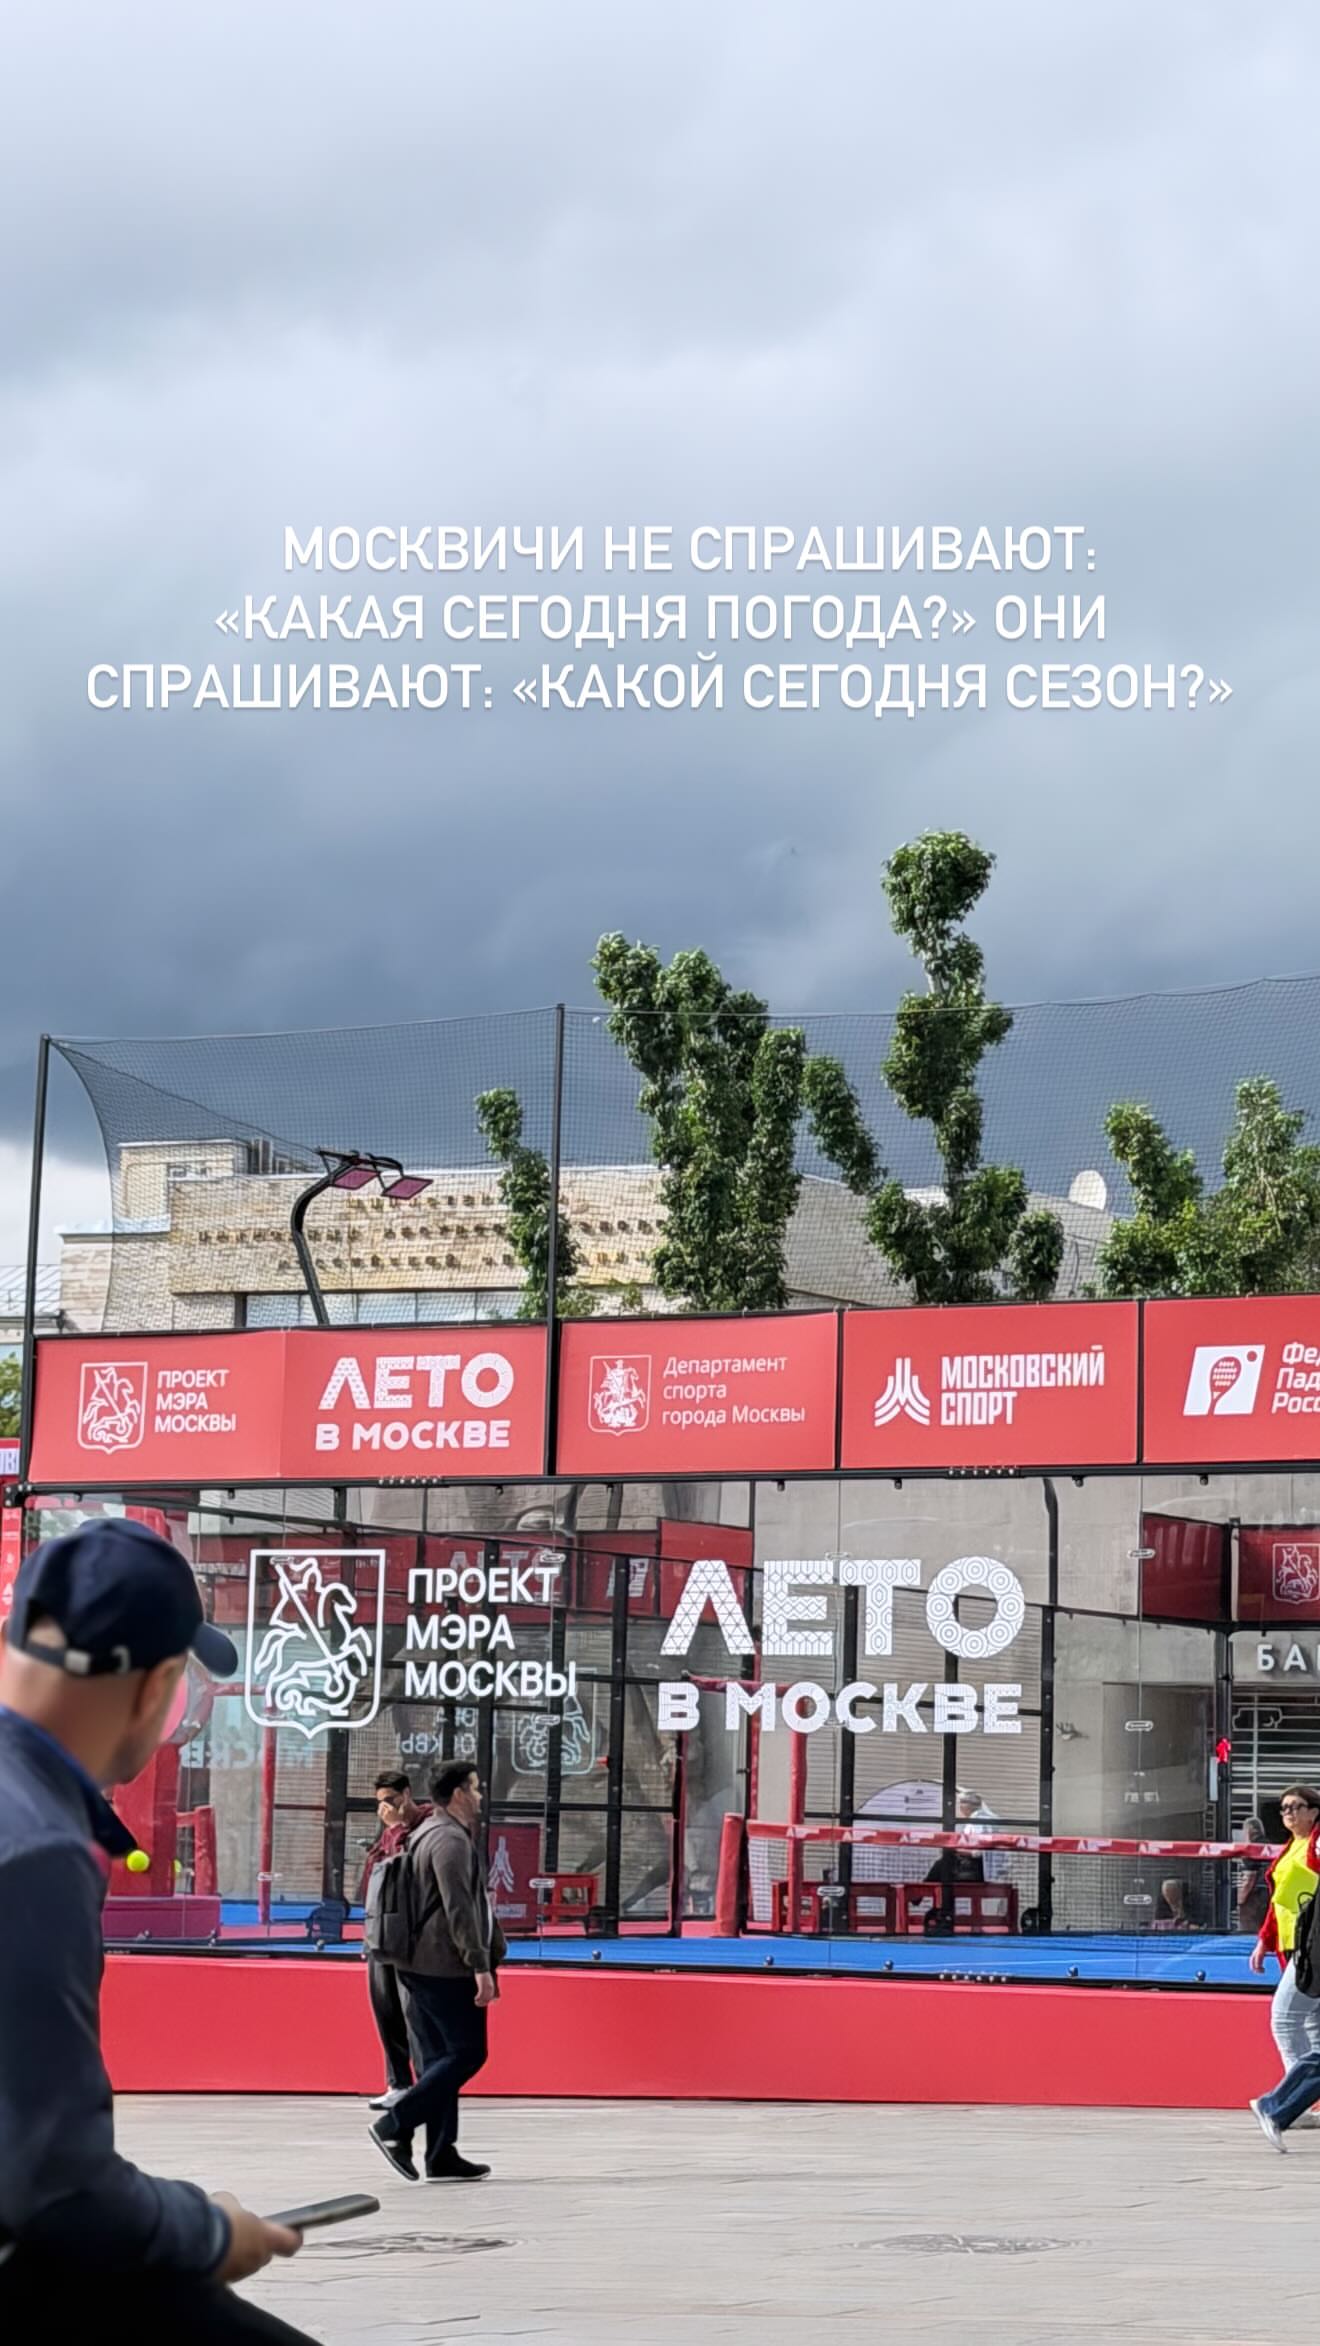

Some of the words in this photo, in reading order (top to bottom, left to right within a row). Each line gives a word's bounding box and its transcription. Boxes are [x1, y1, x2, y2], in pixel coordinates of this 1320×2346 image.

[663, 1356, 788, 1378] Департамент
[941, 1344, 1105, 1390] МОСКОВСКИЙ
[1281, 1341, 1320, 1367] Фе
[157, 1369, 230, 1389] ПРОЕКТ
[318, 1352, 514, 1410] ЛЕТО
[663, 1384, 727, 1404] спорта
[156, 1391, 209, 1411] МЭРА
[940, 1391, 1018, 1426] СПОРТ
[154, 1412, 236, 1433] МОСКВЫ
[662, 1409, 727, 1430] города
[732, 1405, 805, 1424] Москвы
[315, 1423, 340, 1451] В
[352, 1420, 511, 1451] МОСКВЕ
[407, 1566, 560, 1604] ПРОЕКТ
[660, 1555, 1026, 1659] ЛЕТО
[405, 1613, 516, 1651] МЭРА
[1256, 1643, 1320, 1672] БА
[404, 1660, 577, 1698] МОСКВЫ
[657, 1682, 699, 1731] В
[726, 1681, 1023, 1734] МОСКВЕ
